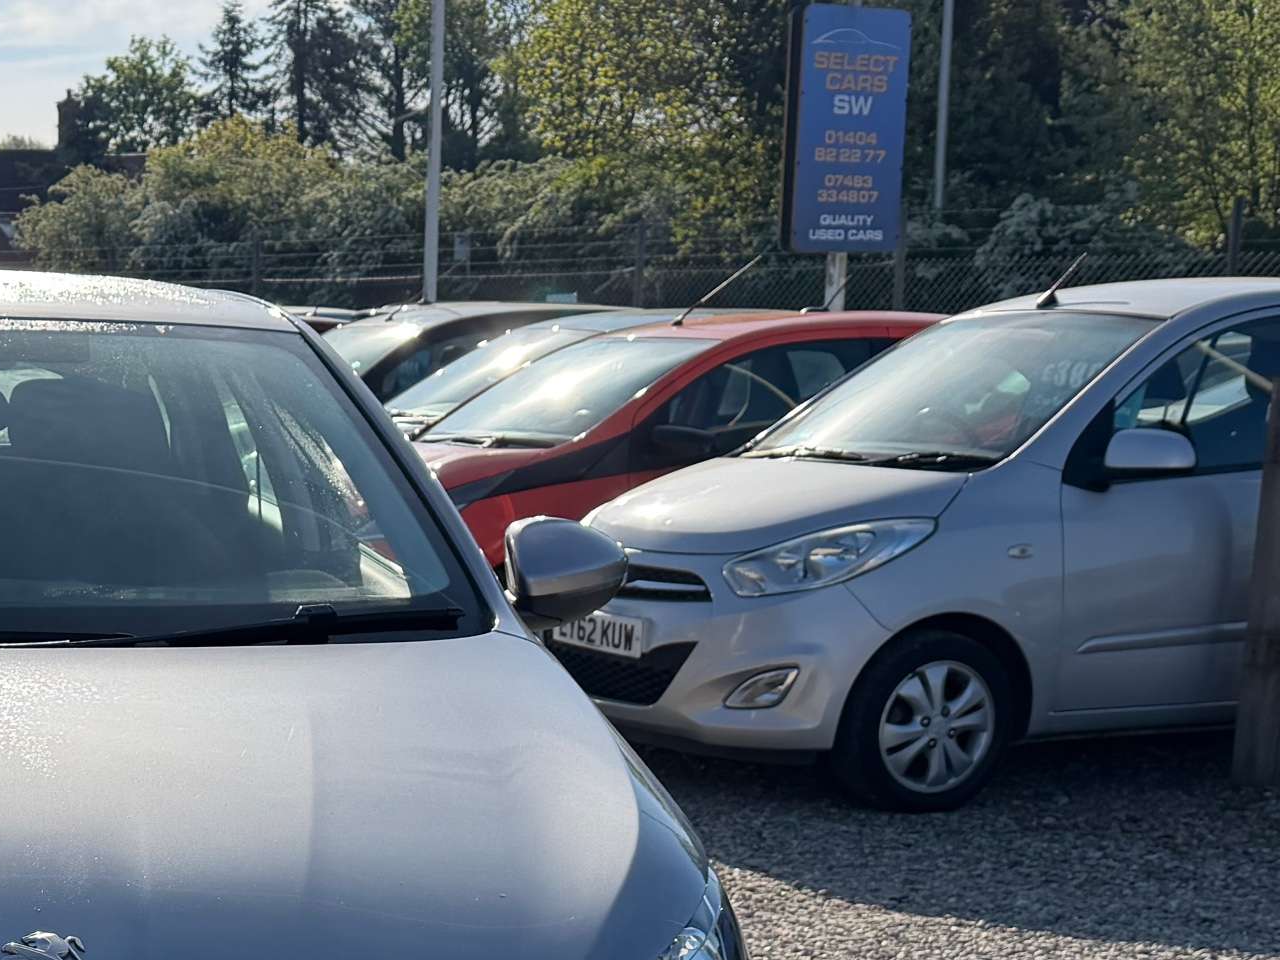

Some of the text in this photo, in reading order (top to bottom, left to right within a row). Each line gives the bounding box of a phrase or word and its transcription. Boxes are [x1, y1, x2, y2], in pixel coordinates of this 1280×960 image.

[814, 51, 898, 73] SELECT
[825, 72, 888, 93] CARS
[833, 94, 873, 116] SW
[824, 130, 877, 145] 01404
[824, 174, 873, 188] 07483
[817, 189, 879, 203] 334807
[819, 214, 874, 226] QUALITY
[808, 228, 883, 241] USED CARS
